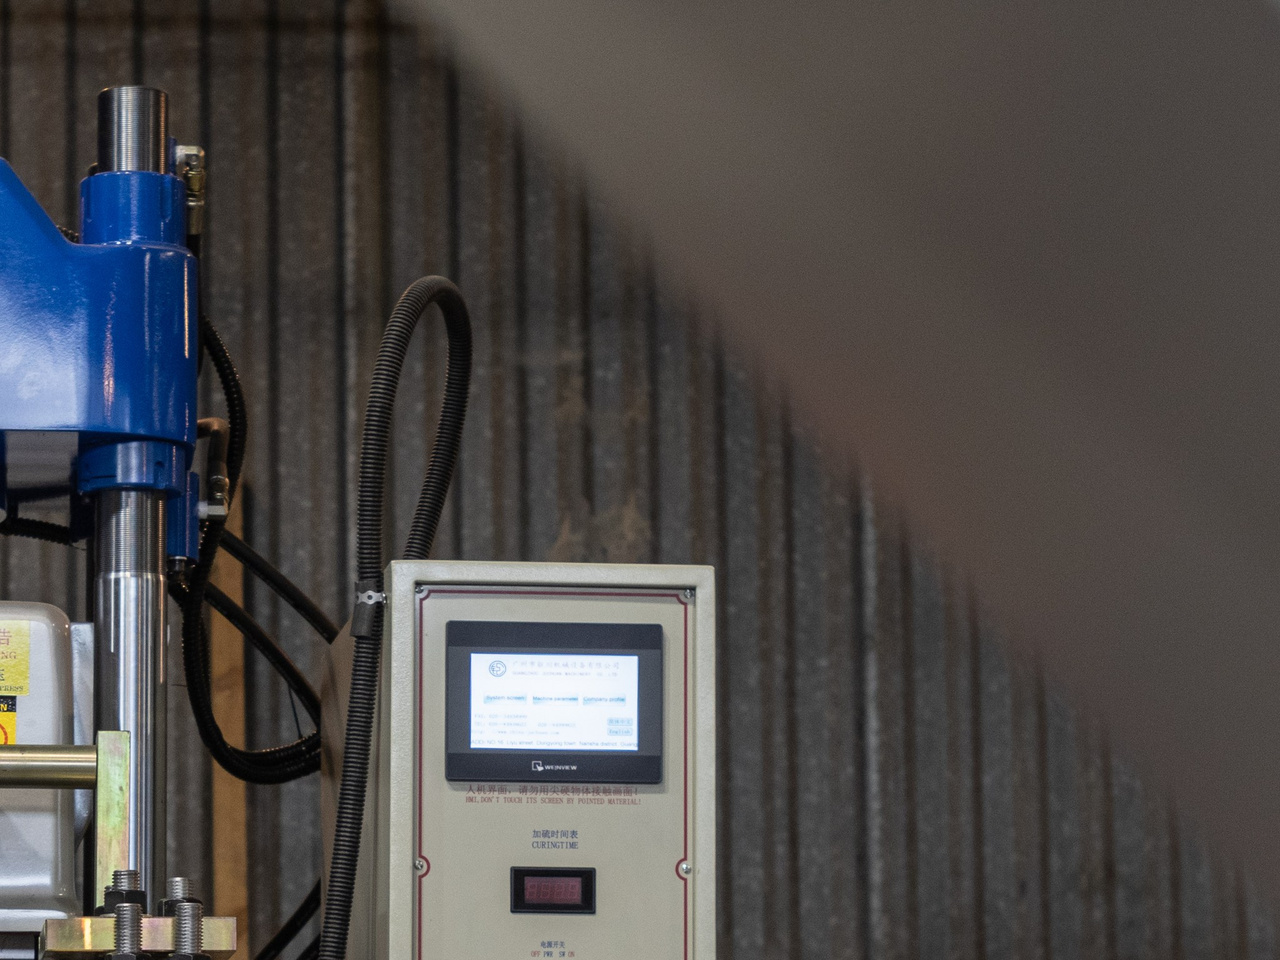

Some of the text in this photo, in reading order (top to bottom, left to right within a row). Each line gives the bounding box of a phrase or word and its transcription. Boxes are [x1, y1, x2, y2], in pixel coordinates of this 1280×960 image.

[503, 796, 523, 804] TOUCH
[577, 797, 605, 805] POINTED
[532, 829, 579, 839] 加硫时间表
[531, 841, 579, 849] CURINGTIME
